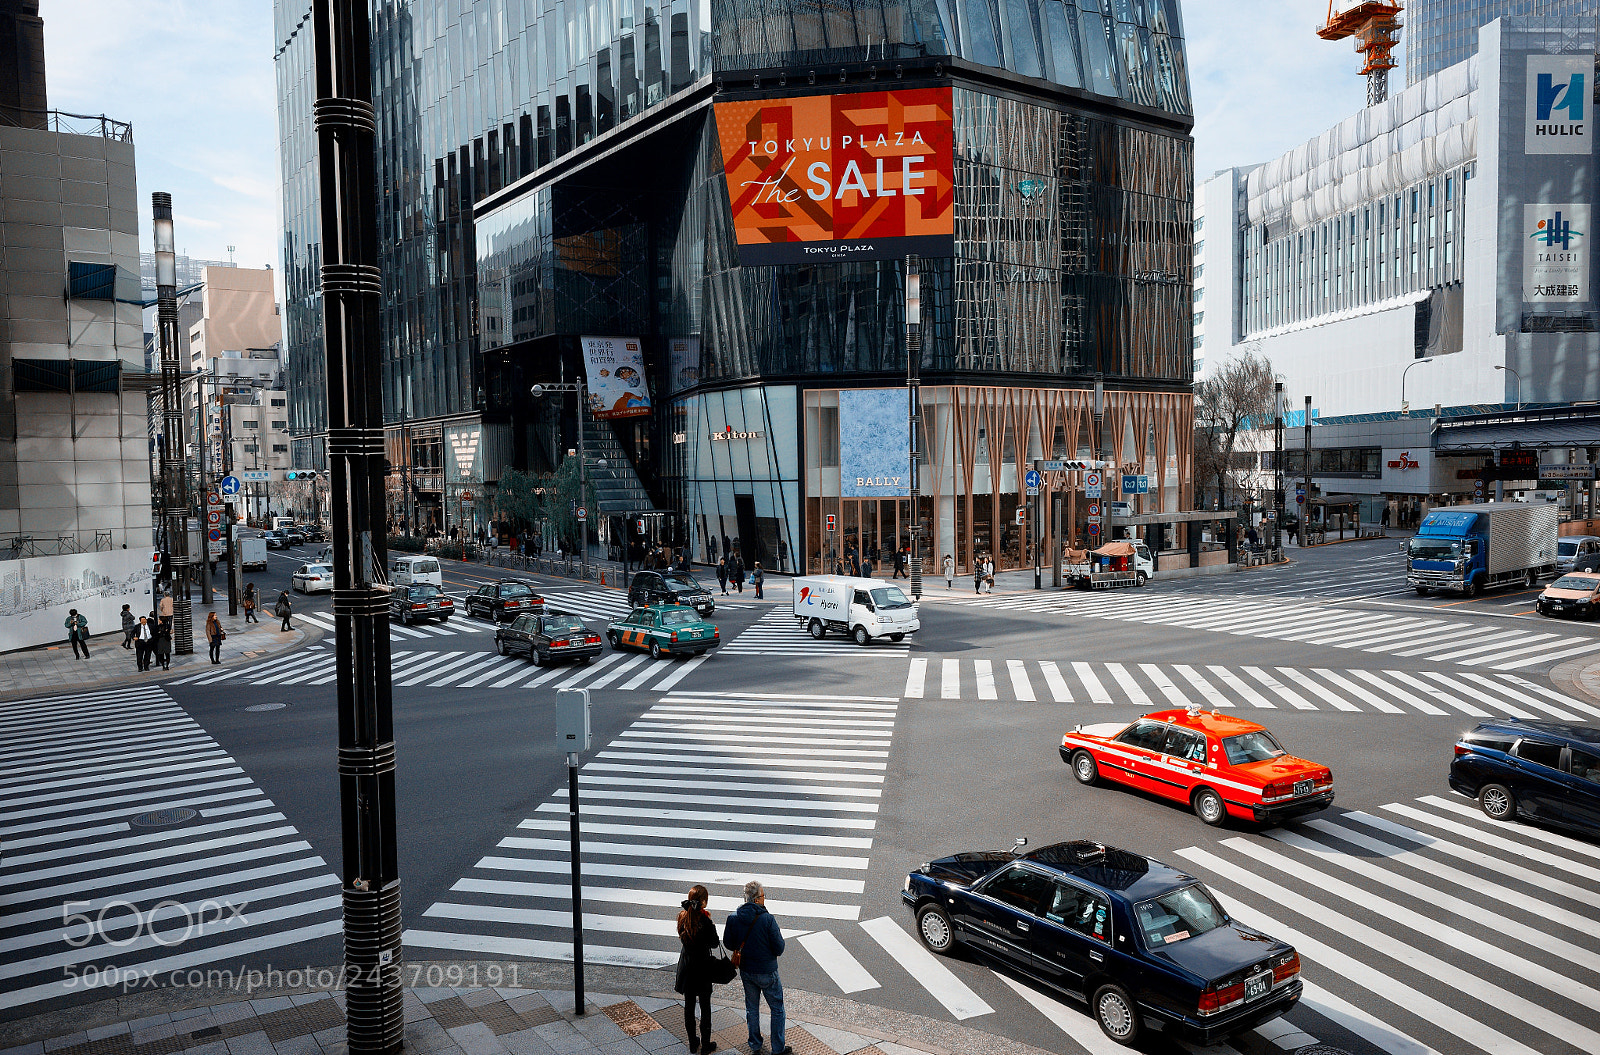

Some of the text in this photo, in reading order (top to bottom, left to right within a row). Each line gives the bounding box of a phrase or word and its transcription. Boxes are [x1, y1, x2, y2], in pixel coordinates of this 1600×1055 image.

[1535, 124, 1584, 136] HULIC
[749, 131, 924, 155] TOKYU PLAZA
[740, 156, 925, 206] the SALE
[803, 246, 837, 254] TOKYU
[1538, 253, 1577, 262] TAISEI
[1533, 284, 1579, 297] 大成建設
[713, 426, 757, 441] Kiton
[856, 476, 901, 487] BALLY
